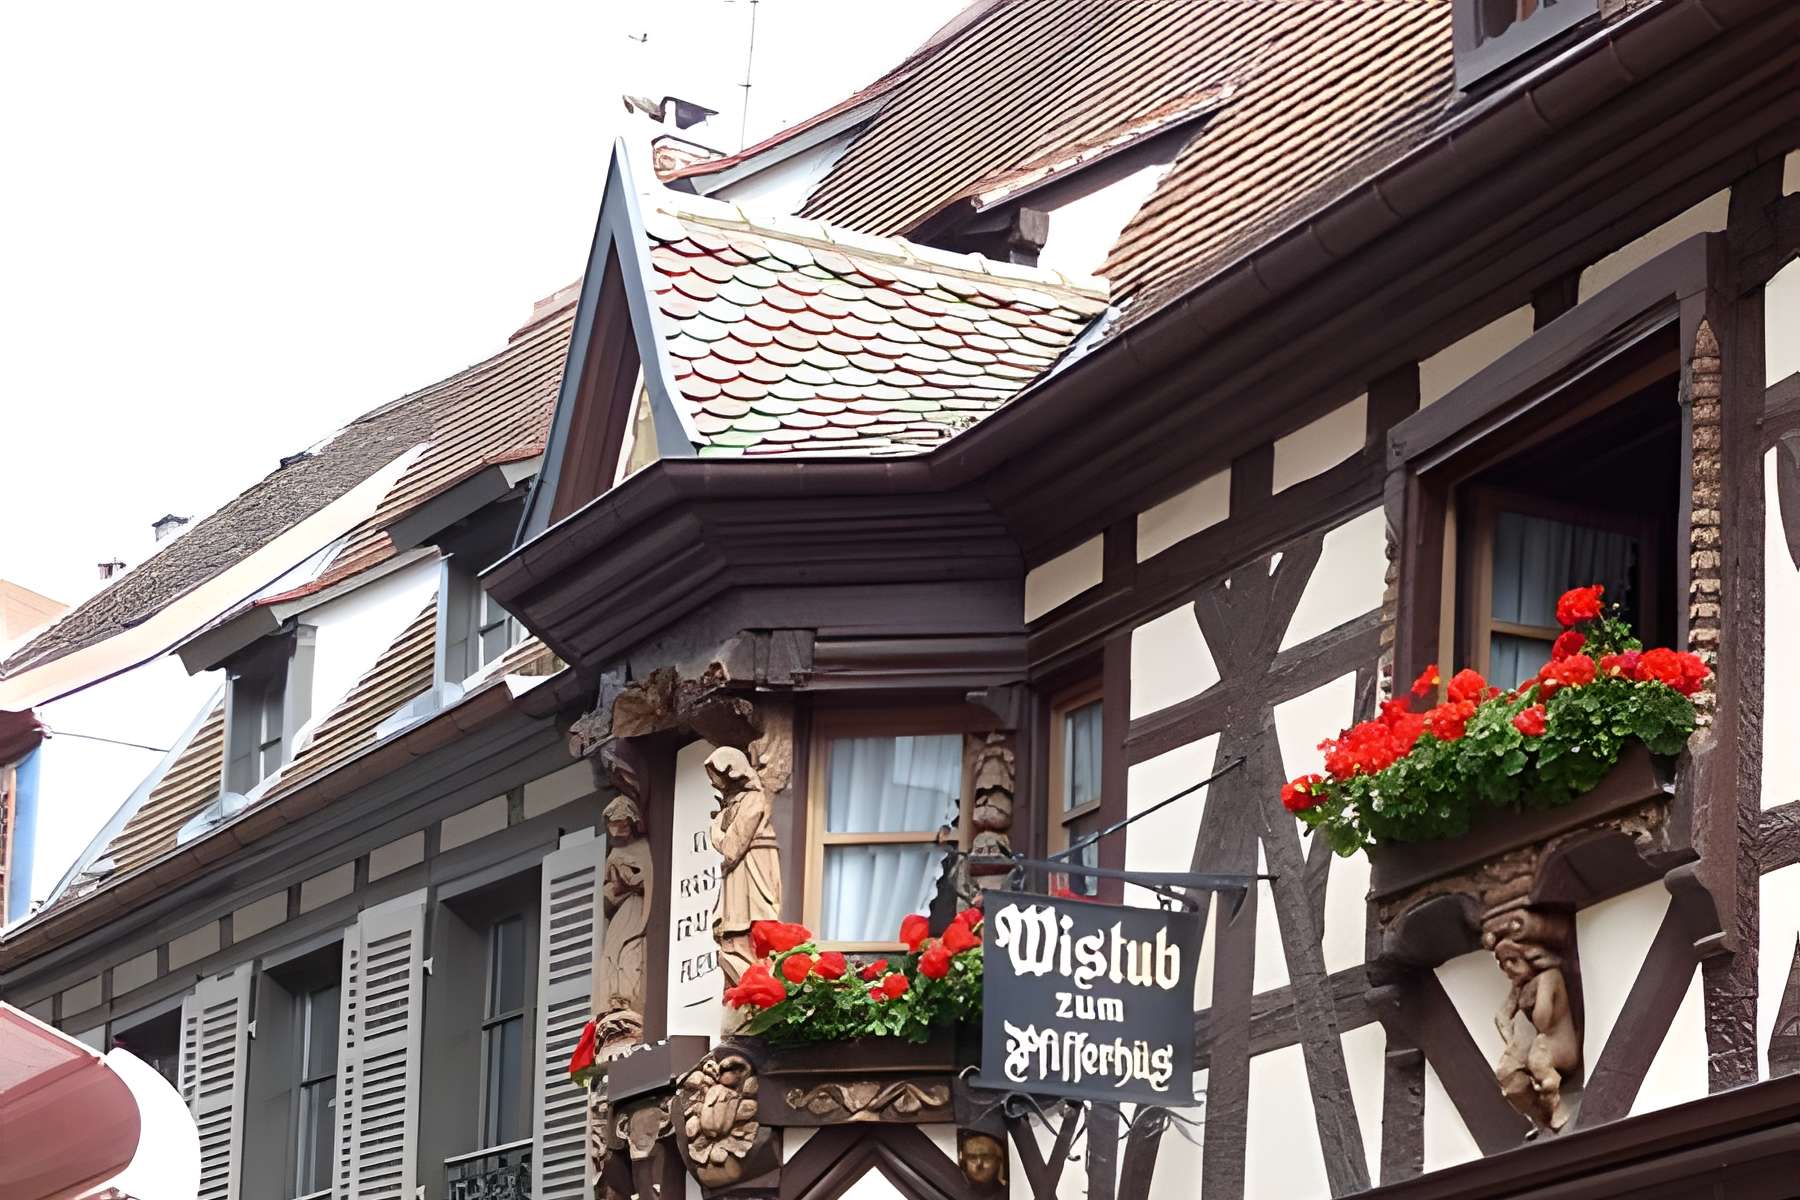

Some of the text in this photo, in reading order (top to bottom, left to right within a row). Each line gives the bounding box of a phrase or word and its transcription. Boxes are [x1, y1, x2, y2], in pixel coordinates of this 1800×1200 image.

[995, 903, 1181, 990] Wistub
[1055, 992, 1124, 1022] zum
[1003, 1019, 1173, 1092] Pfifferhüs
